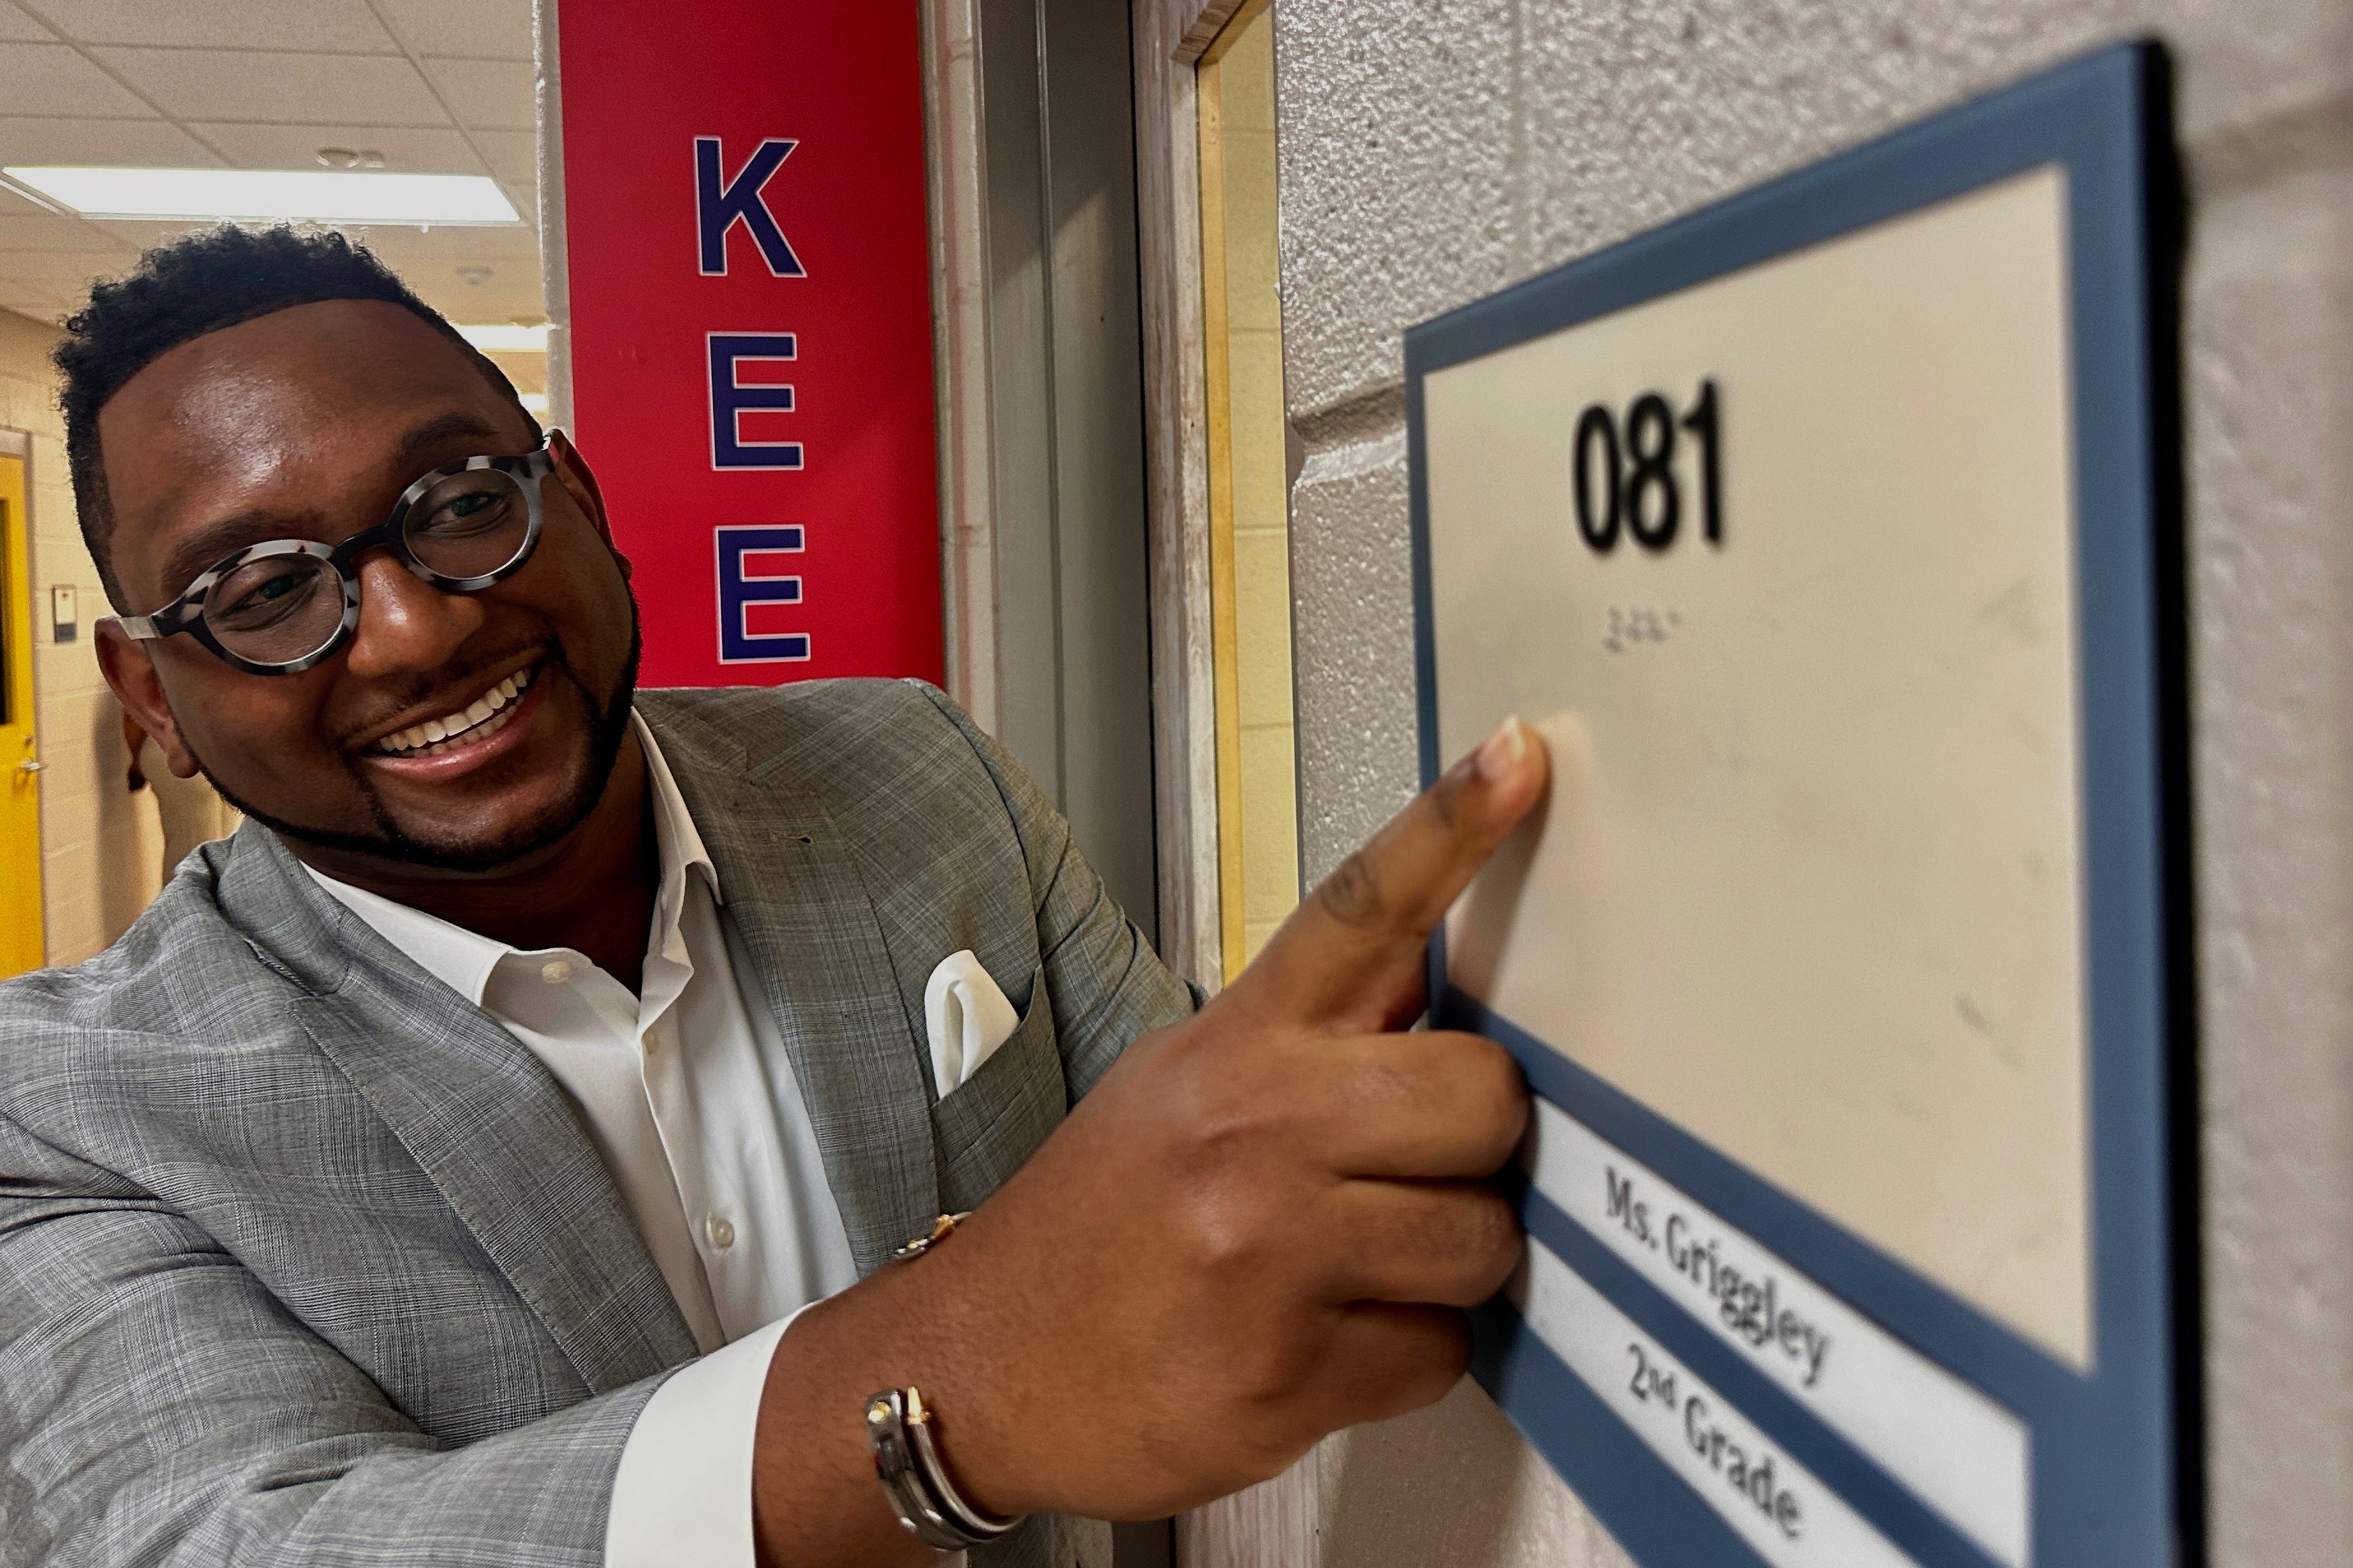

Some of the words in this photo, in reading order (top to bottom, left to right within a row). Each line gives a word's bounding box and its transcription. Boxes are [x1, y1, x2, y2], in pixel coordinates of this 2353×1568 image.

[1572, 376, 1727, 557] 081
[1604, 1164, 1658, 1250] Ms.
[1665, 1212, 1833, 1388] Griggley
[1626, 1342, 1678, 1409] 2nd
[1683, 1393, 1801, 1540] Grade
